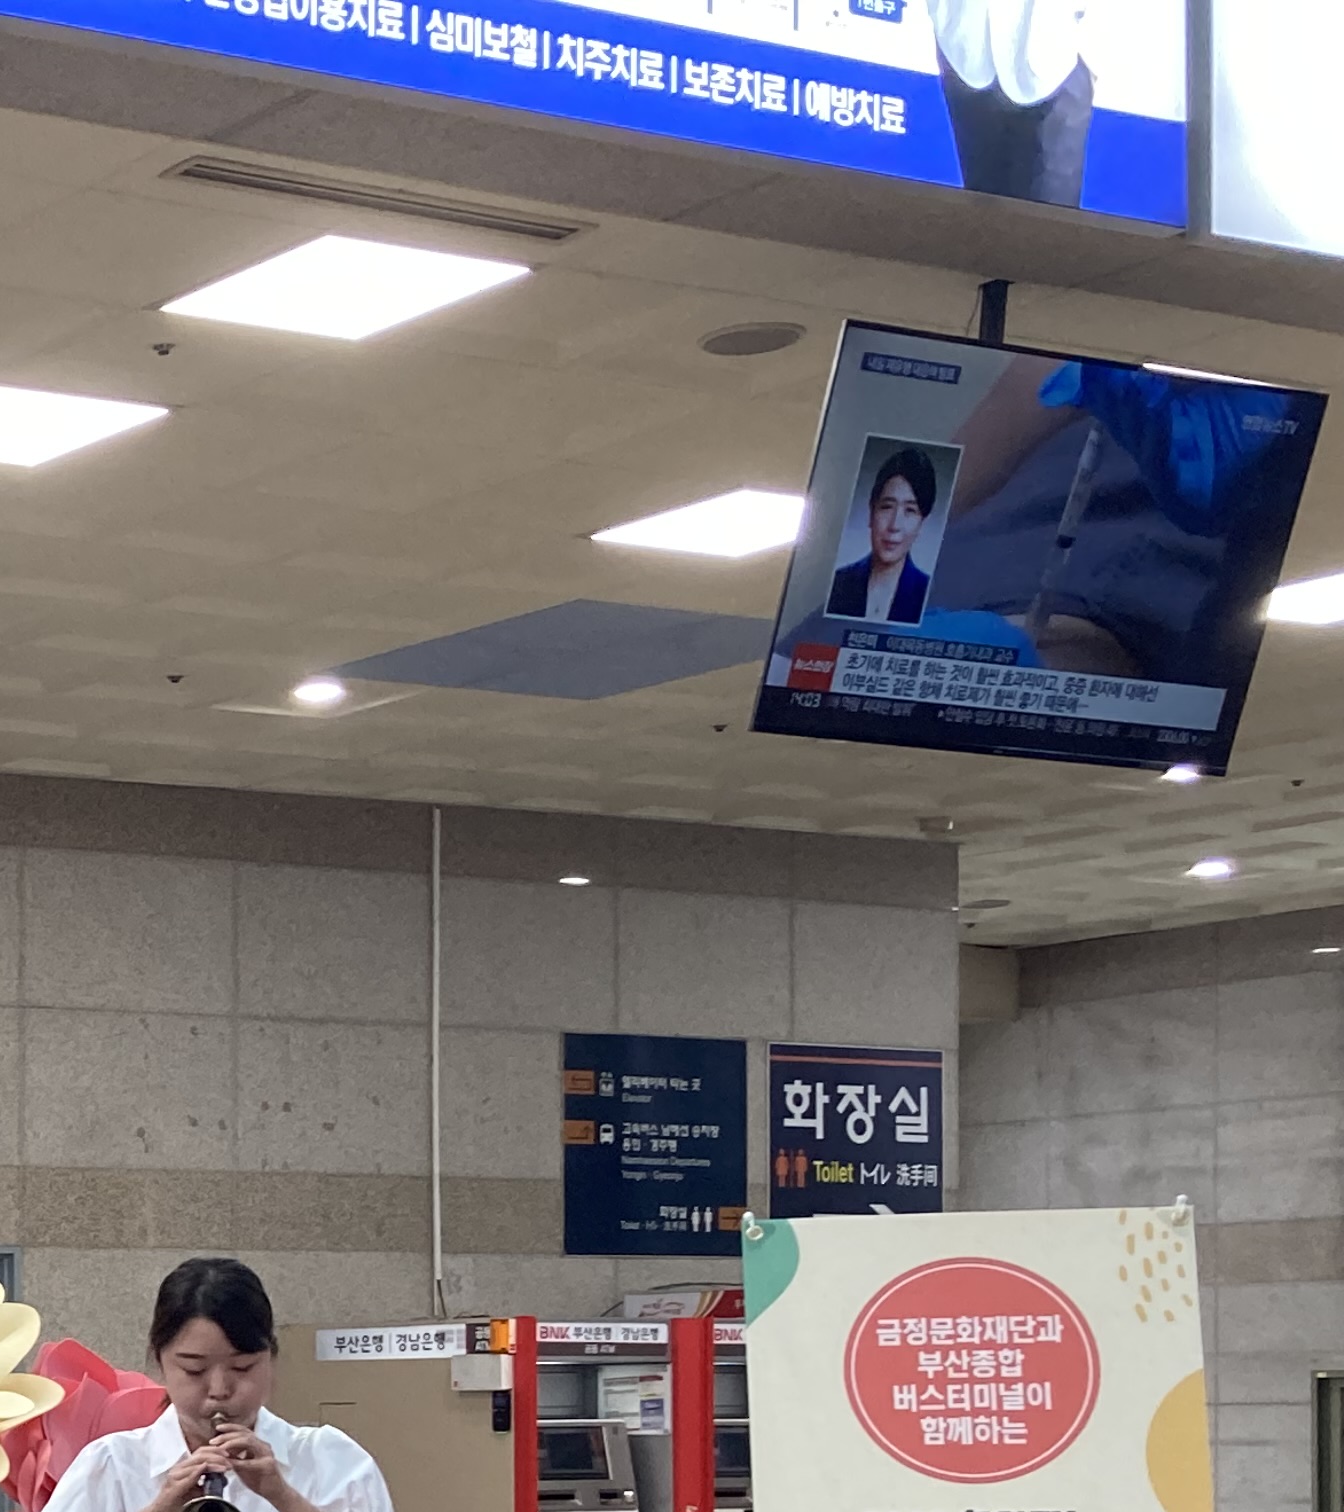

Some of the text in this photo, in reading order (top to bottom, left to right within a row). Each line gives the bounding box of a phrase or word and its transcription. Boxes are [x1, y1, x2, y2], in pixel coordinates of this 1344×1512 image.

[426, 9, 537, 69] 심미보철
[558, 33, 664, 91] 치주치료
[685, 57, 786, 112] 보존치료
[805, 79, 906, 134] 예방치료
[783, 1079, 929, 1145] 화장실
[812, 1160, 854, 1183] Toilet
[334, 1332, 445, 1353] 부산은행 경남은행
[540, 1326, 659, 1341] BNK 부산은행 경남은행
[715, 1327, 742, 1341] BNK
[875, 1313, 1064, 1346] 금정문화재단과
[917, 1349, 1025, 1379] 부산종합
[892, 1381, 1053, 1413] 버스터미널이
[919, 1414, 1028, 1446] 함께하는
